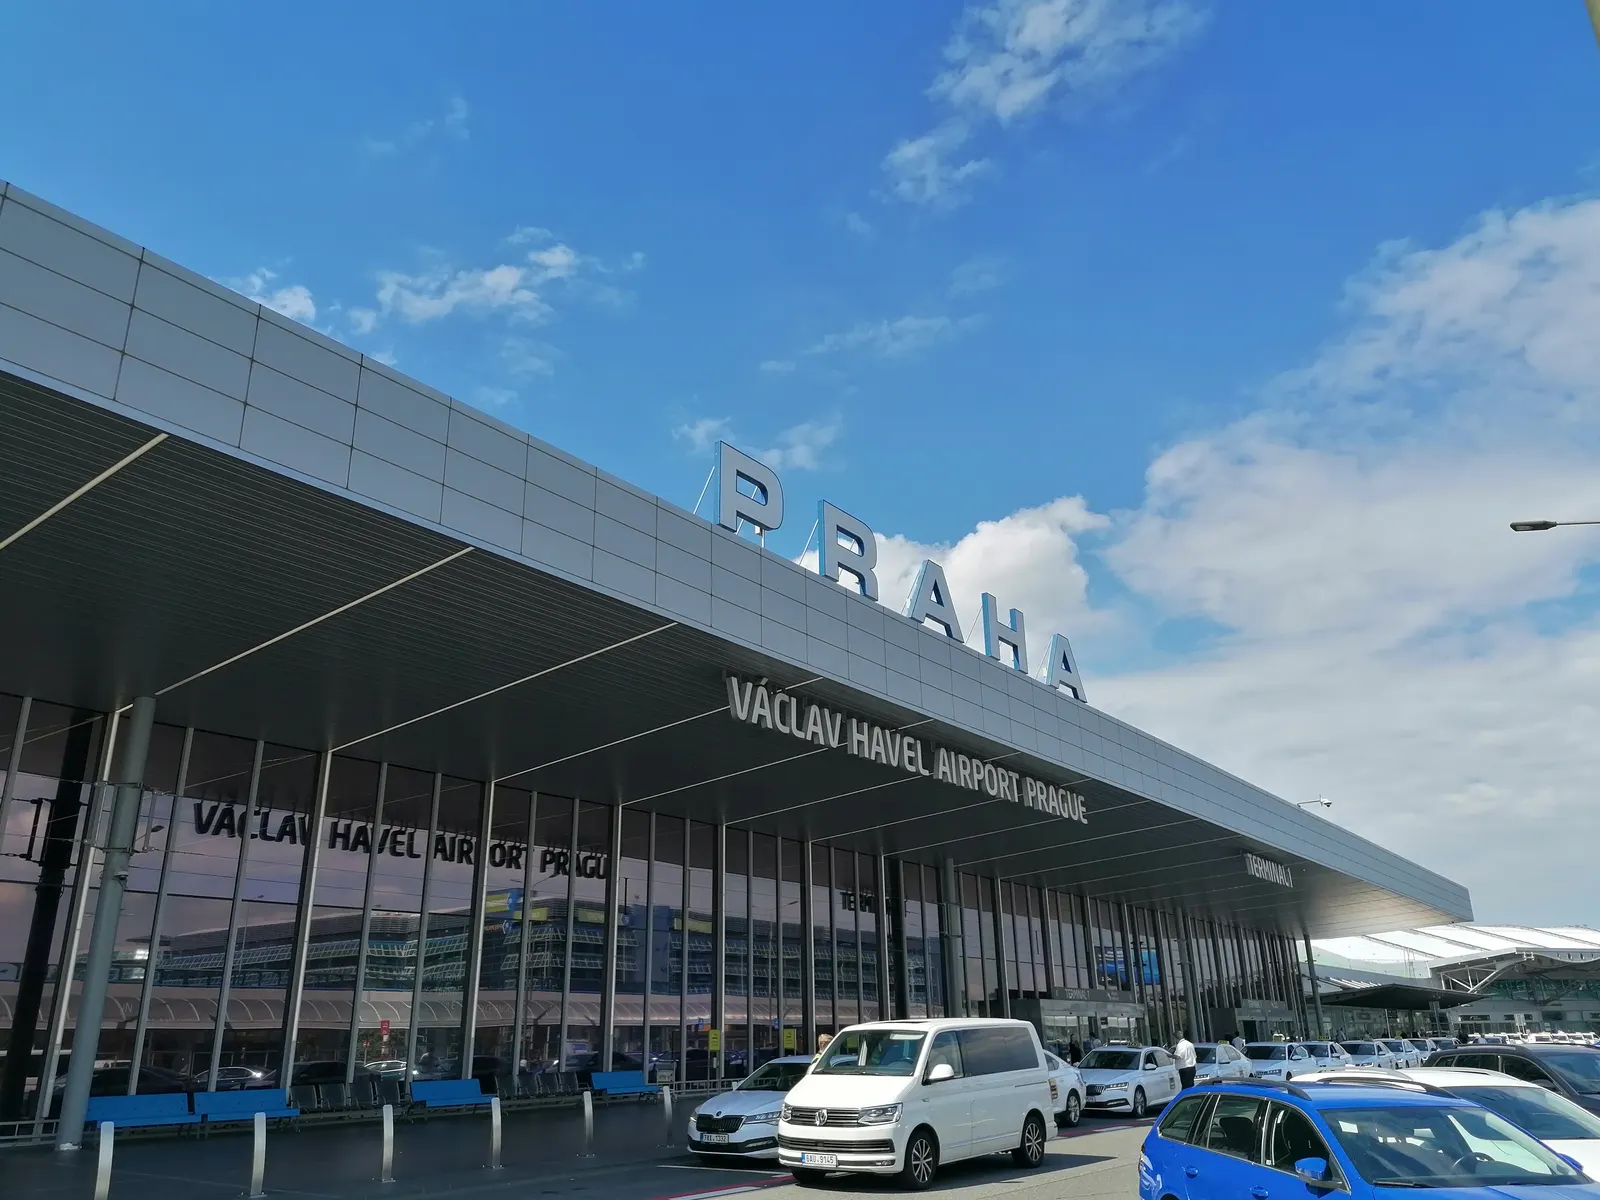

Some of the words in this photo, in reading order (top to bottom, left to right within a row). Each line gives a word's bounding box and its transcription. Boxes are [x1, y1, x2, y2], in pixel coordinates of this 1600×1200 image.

[714, 440, 1087, 703] PRAHA
[726, 676, 842, 748] VÁCLAV
[847, 717, 930, 776] HAVEL
[933, 747, 1019, 803] AIRPORT
[1022, 776, 1088, 825] PRAGUE
